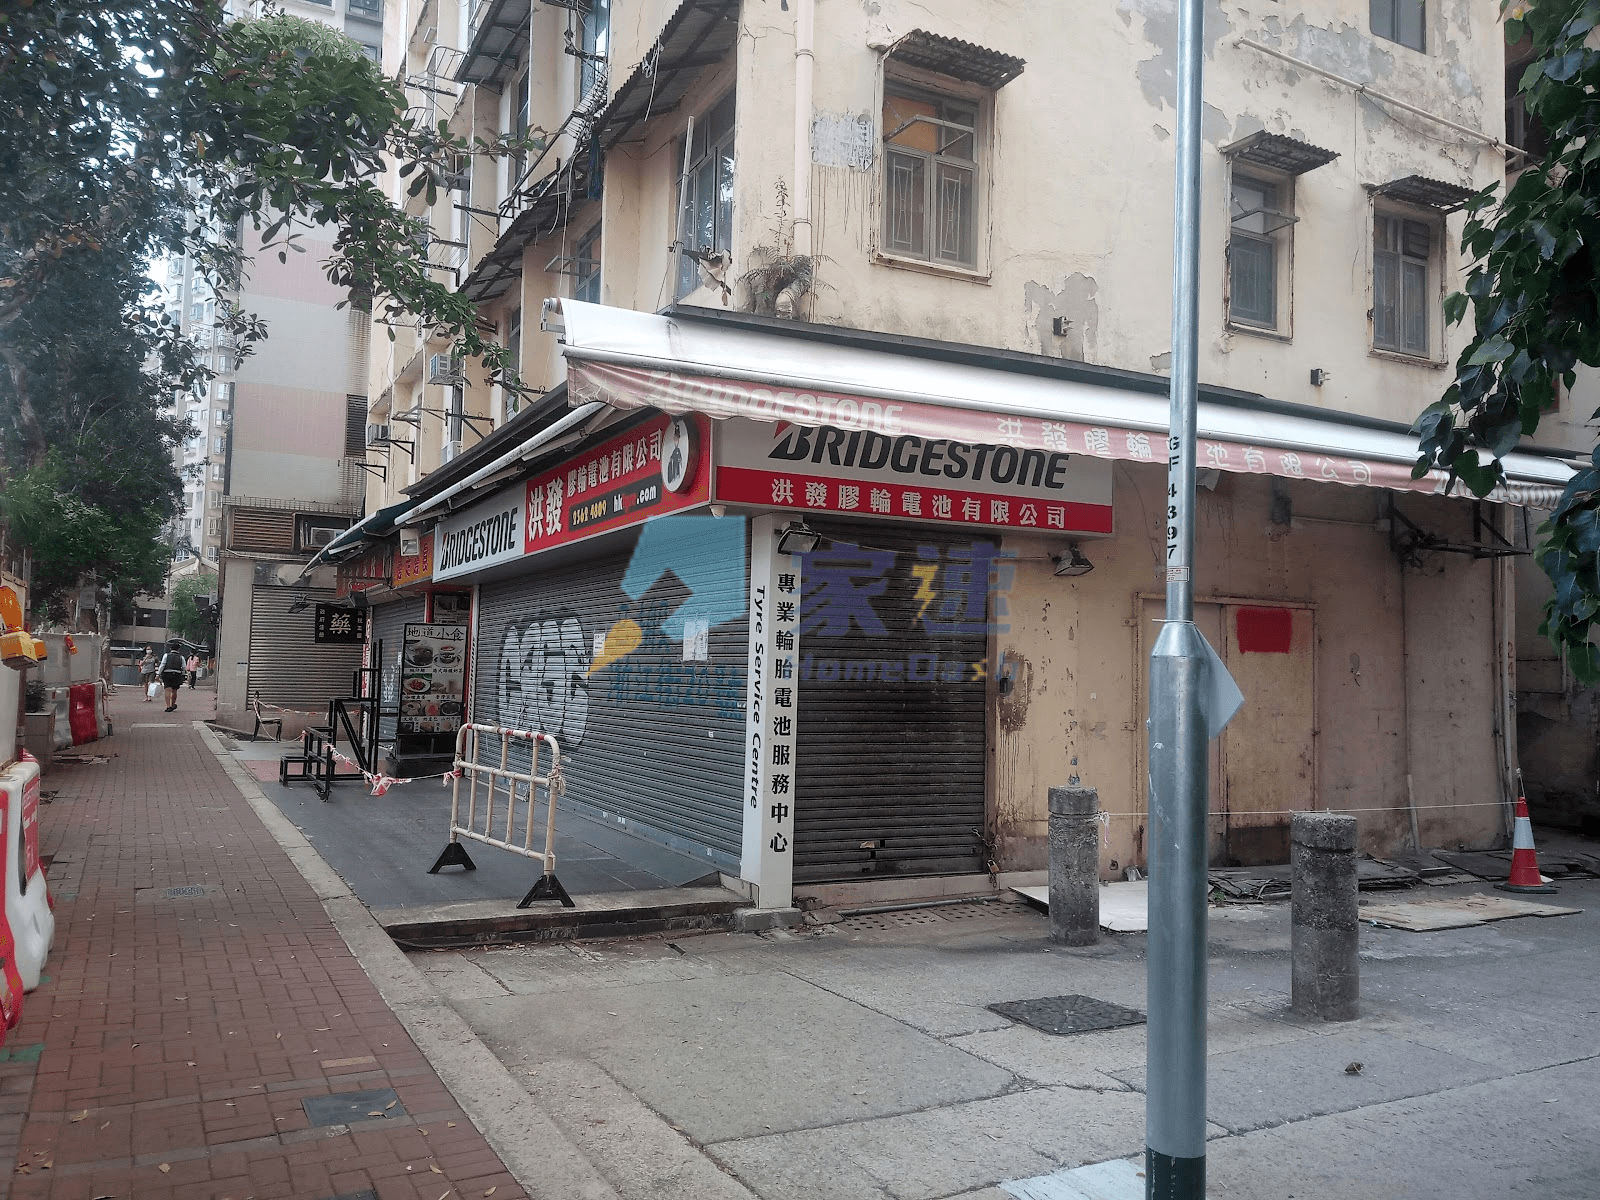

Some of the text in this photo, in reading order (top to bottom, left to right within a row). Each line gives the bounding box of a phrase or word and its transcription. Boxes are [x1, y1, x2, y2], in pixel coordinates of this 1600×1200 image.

[768, 418, 1069, 490] BRIDGESTONE
[997, 417, 1372, 484] 洪發膠輪池有限公司
[528, 428, 663, 543] 洪發 膠輪電池有限公司
[771, 478, 1066, 529] 洪發膠輪電池有限公司
[440, 506, 518, 571] BRIDGESTONE
[329, 612, 352, 635] 藥
[406, 626, 465, 642] 地道小食
[750, 585, 766, 809] Tyre Service Centre
[769, 573, 796, 853] 專業輪胎電池服務中心
